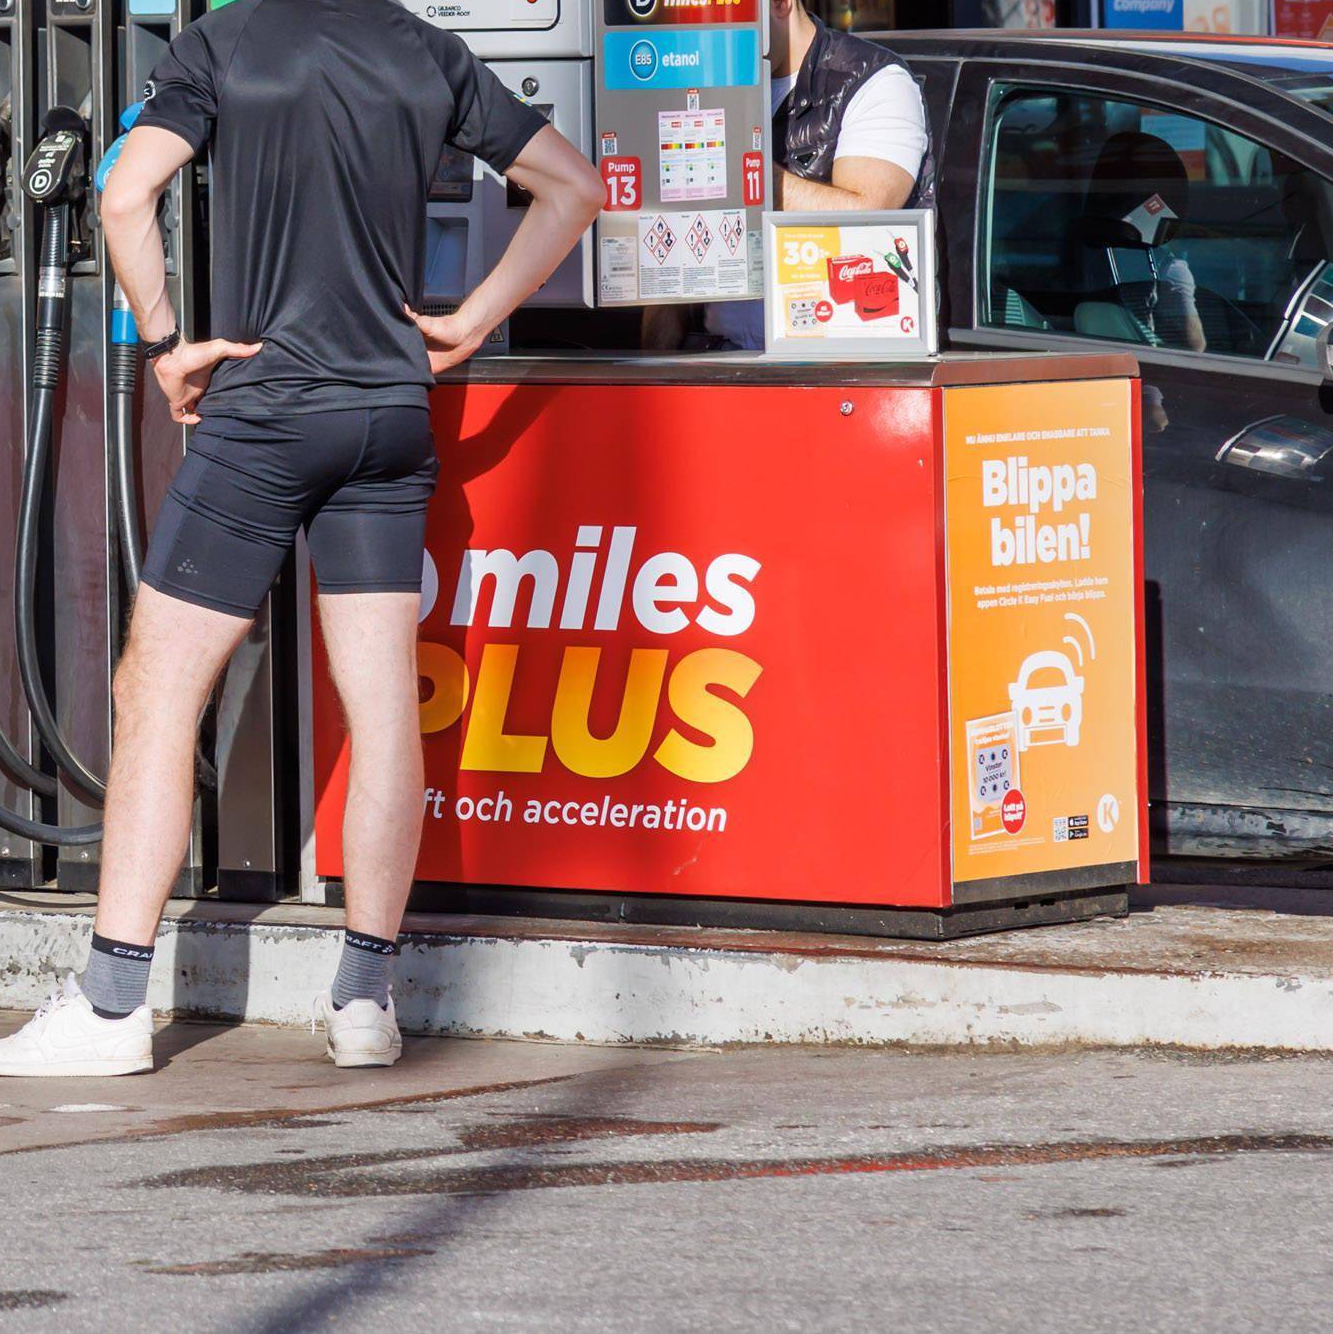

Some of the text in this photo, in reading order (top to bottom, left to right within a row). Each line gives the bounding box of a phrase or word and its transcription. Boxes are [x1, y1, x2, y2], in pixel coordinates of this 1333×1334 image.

[635, 51, 699, 66] E85 etanol
[608, 162, 635, 173] Pump
[745, 157, 760, 168] Pump
[34, 175, 47, 188] D
[607, 176, 636, 206] 13
[747, 171, 760, 200] 11
[983, 456, 1097, 514] Blippa
[991, 513, 1090, 566] bilen!
[449, 525, 762, 637] miles
[455, 791, 728, 832] och acceleration
